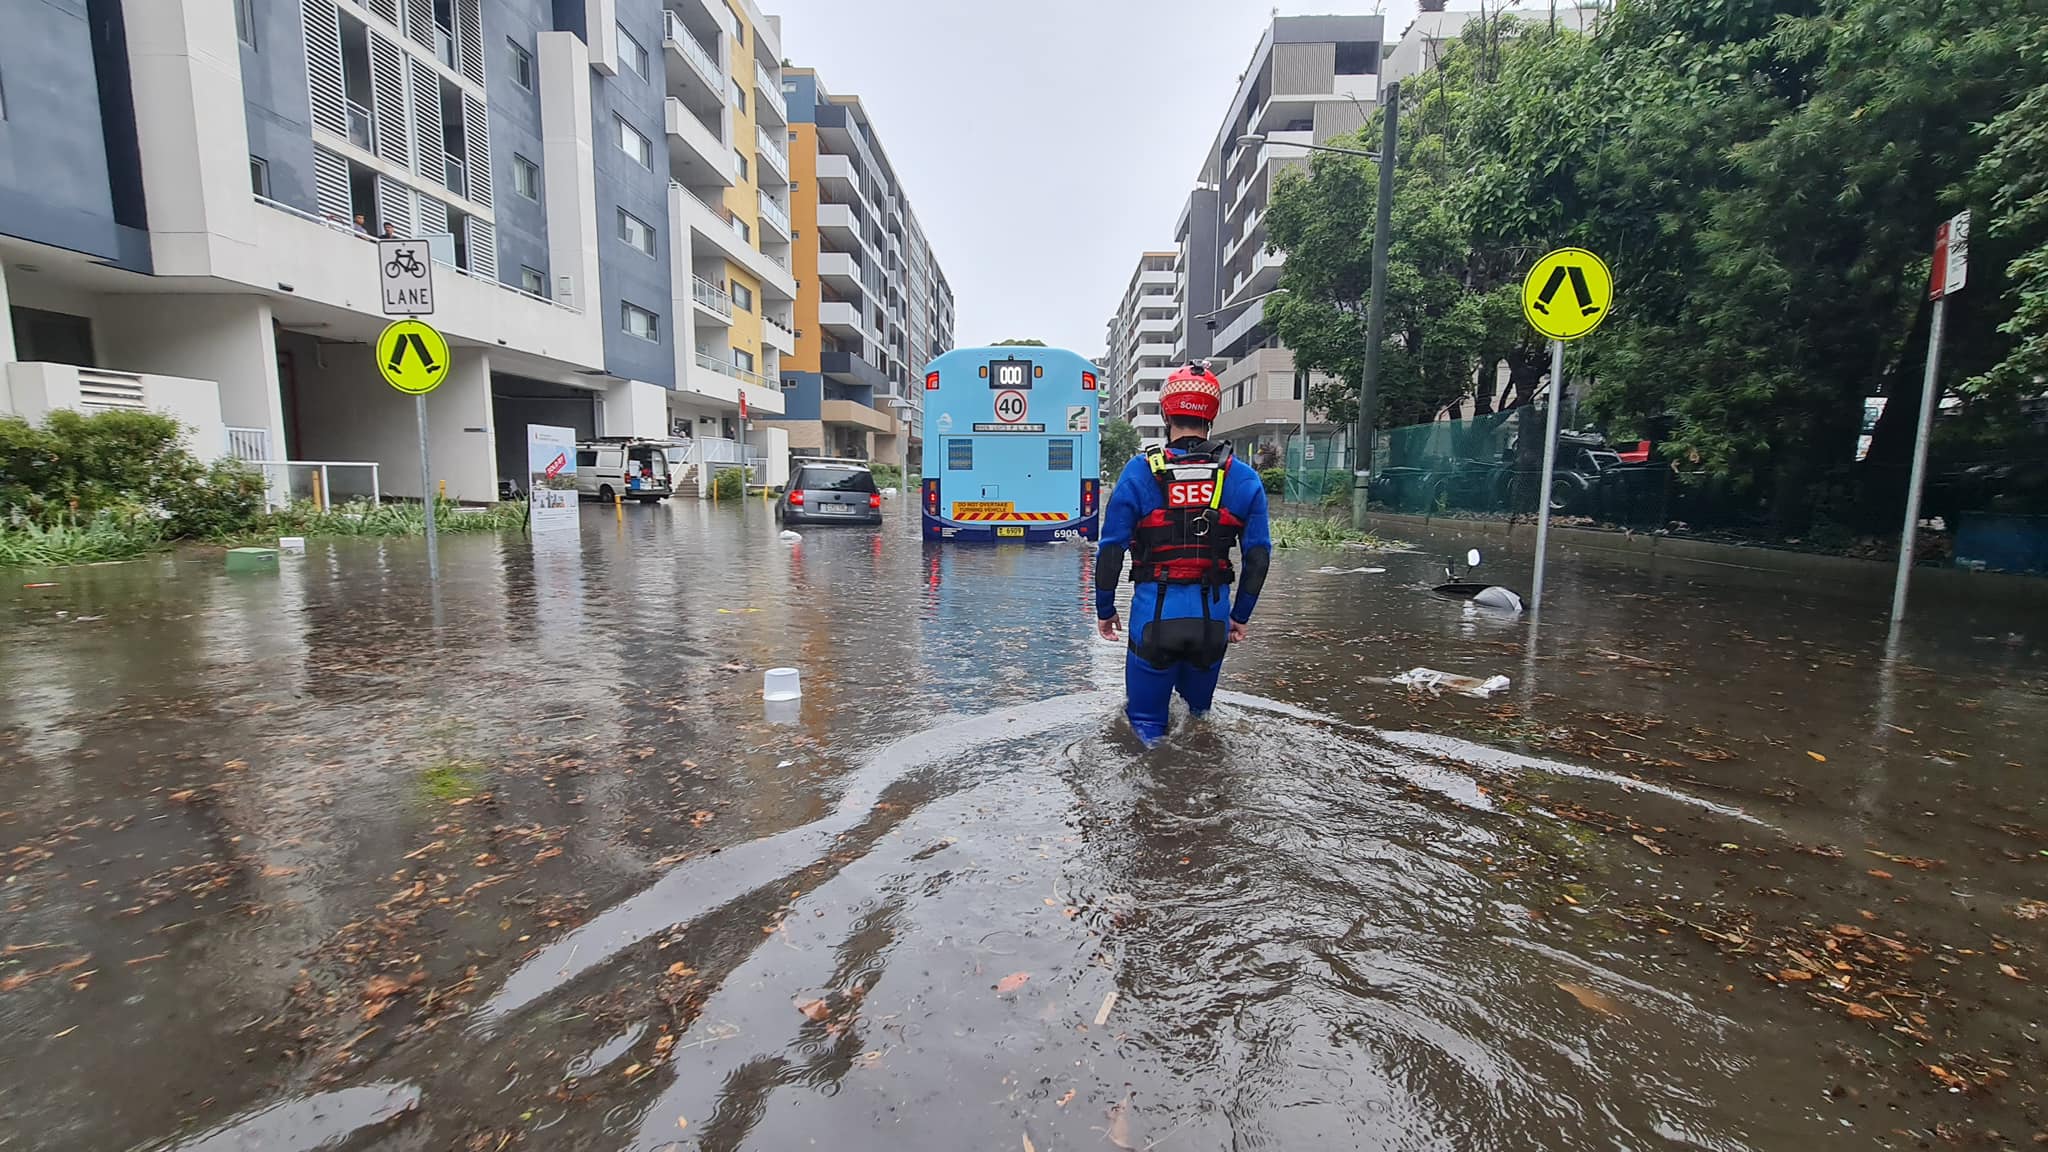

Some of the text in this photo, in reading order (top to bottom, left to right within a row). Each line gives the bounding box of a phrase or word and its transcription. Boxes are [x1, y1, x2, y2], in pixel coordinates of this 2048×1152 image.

[386, 289, 429, 305] LANE
[1000, 366, 1022, 385] 000
[999, 398, 1023, 415] 40
[1180, 401, 1209, 411] SONNY
[1171, 483, 1213, 504] SES
[1054, 529, 1078, 538] 6909
